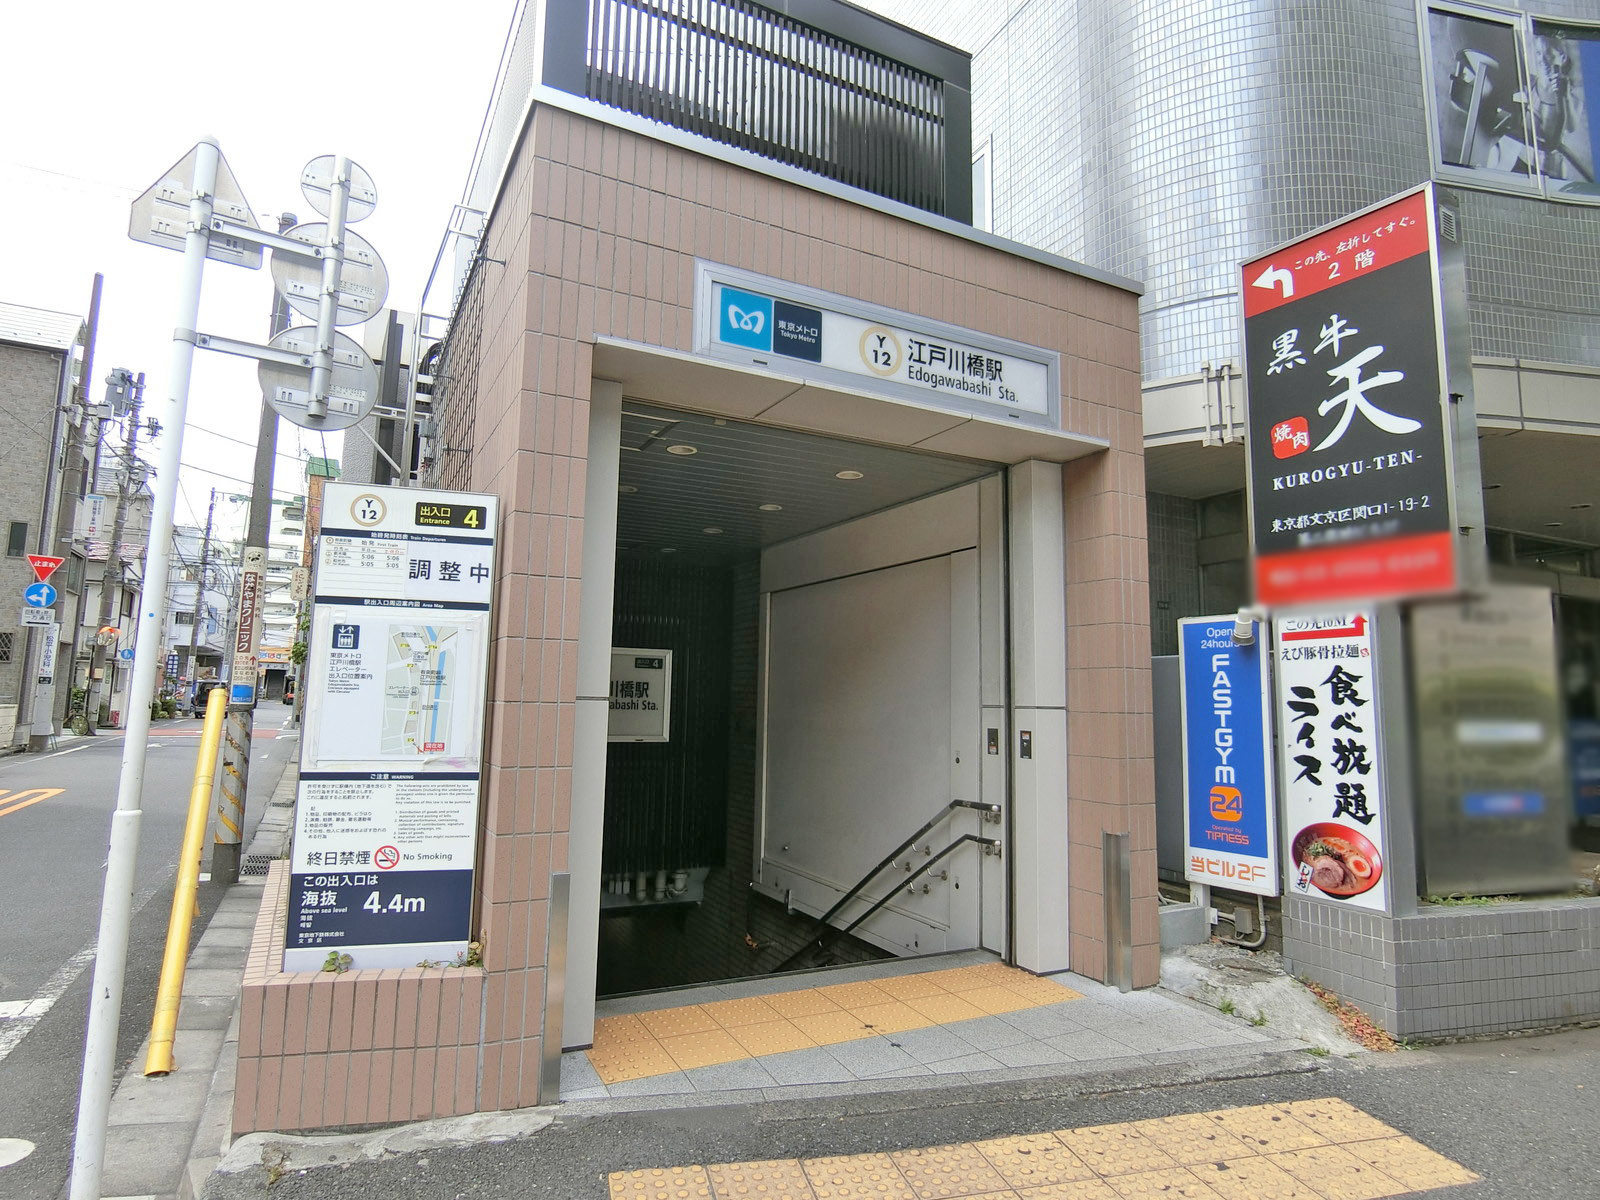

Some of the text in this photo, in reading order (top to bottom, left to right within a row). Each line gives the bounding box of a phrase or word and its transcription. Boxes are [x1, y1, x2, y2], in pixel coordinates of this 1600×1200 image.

[1294, 216, 1416, 271] この先、左折してすぐ。
[778, 320, 818, 336] 東京メトロ
[780, 330, 816, 344] Tokyo Metro
[876, 334, 887, 348] Y
[872, 350, 892, 367] 12
[908, 338, 1003, 382] 江戸川橋駅
[908, 365, 1019, 403] Edogawabashi Sta.
[1274, 424, 1310, 450] 焼肉
[1272, 449, 1423, 491] KUROGYU-TEN-
[365, 500, 374, 508] Y
[420, 506, 451, 517] 出入口
[361, 510, 377, 520] 12
[464, 509, 479, 528] 4
[1270, 496, 1430, 533] 東京都文京区関口1-19-2
[409, 559, 489, 584] 調整中
[238, 573, 256, 651] なかやまクリニック
[1206, 628, 1233, 638] Open
[1282, 644, 1360, 661] えび豚骨拉麺
[652, 660, 659, 668] 4
[642, 700, 658, 710] Sta.
[1287, 686, 1323, 786] ライス
[1320, 664, 1376, 826] 食べ放題
[1210, 793, 1242, 814] 24
[1205, 830, 1250, 845] TIPNESS
[306, 850, 453, 866] 終日禁煙 No Smoking
[1191, 856, 1266, 882] 当ビル2F
[304, 875, 379, 887] この出入口は
[302, 890, 338, 907] 海抜
[363, 891, 426, 914] 4.4m
